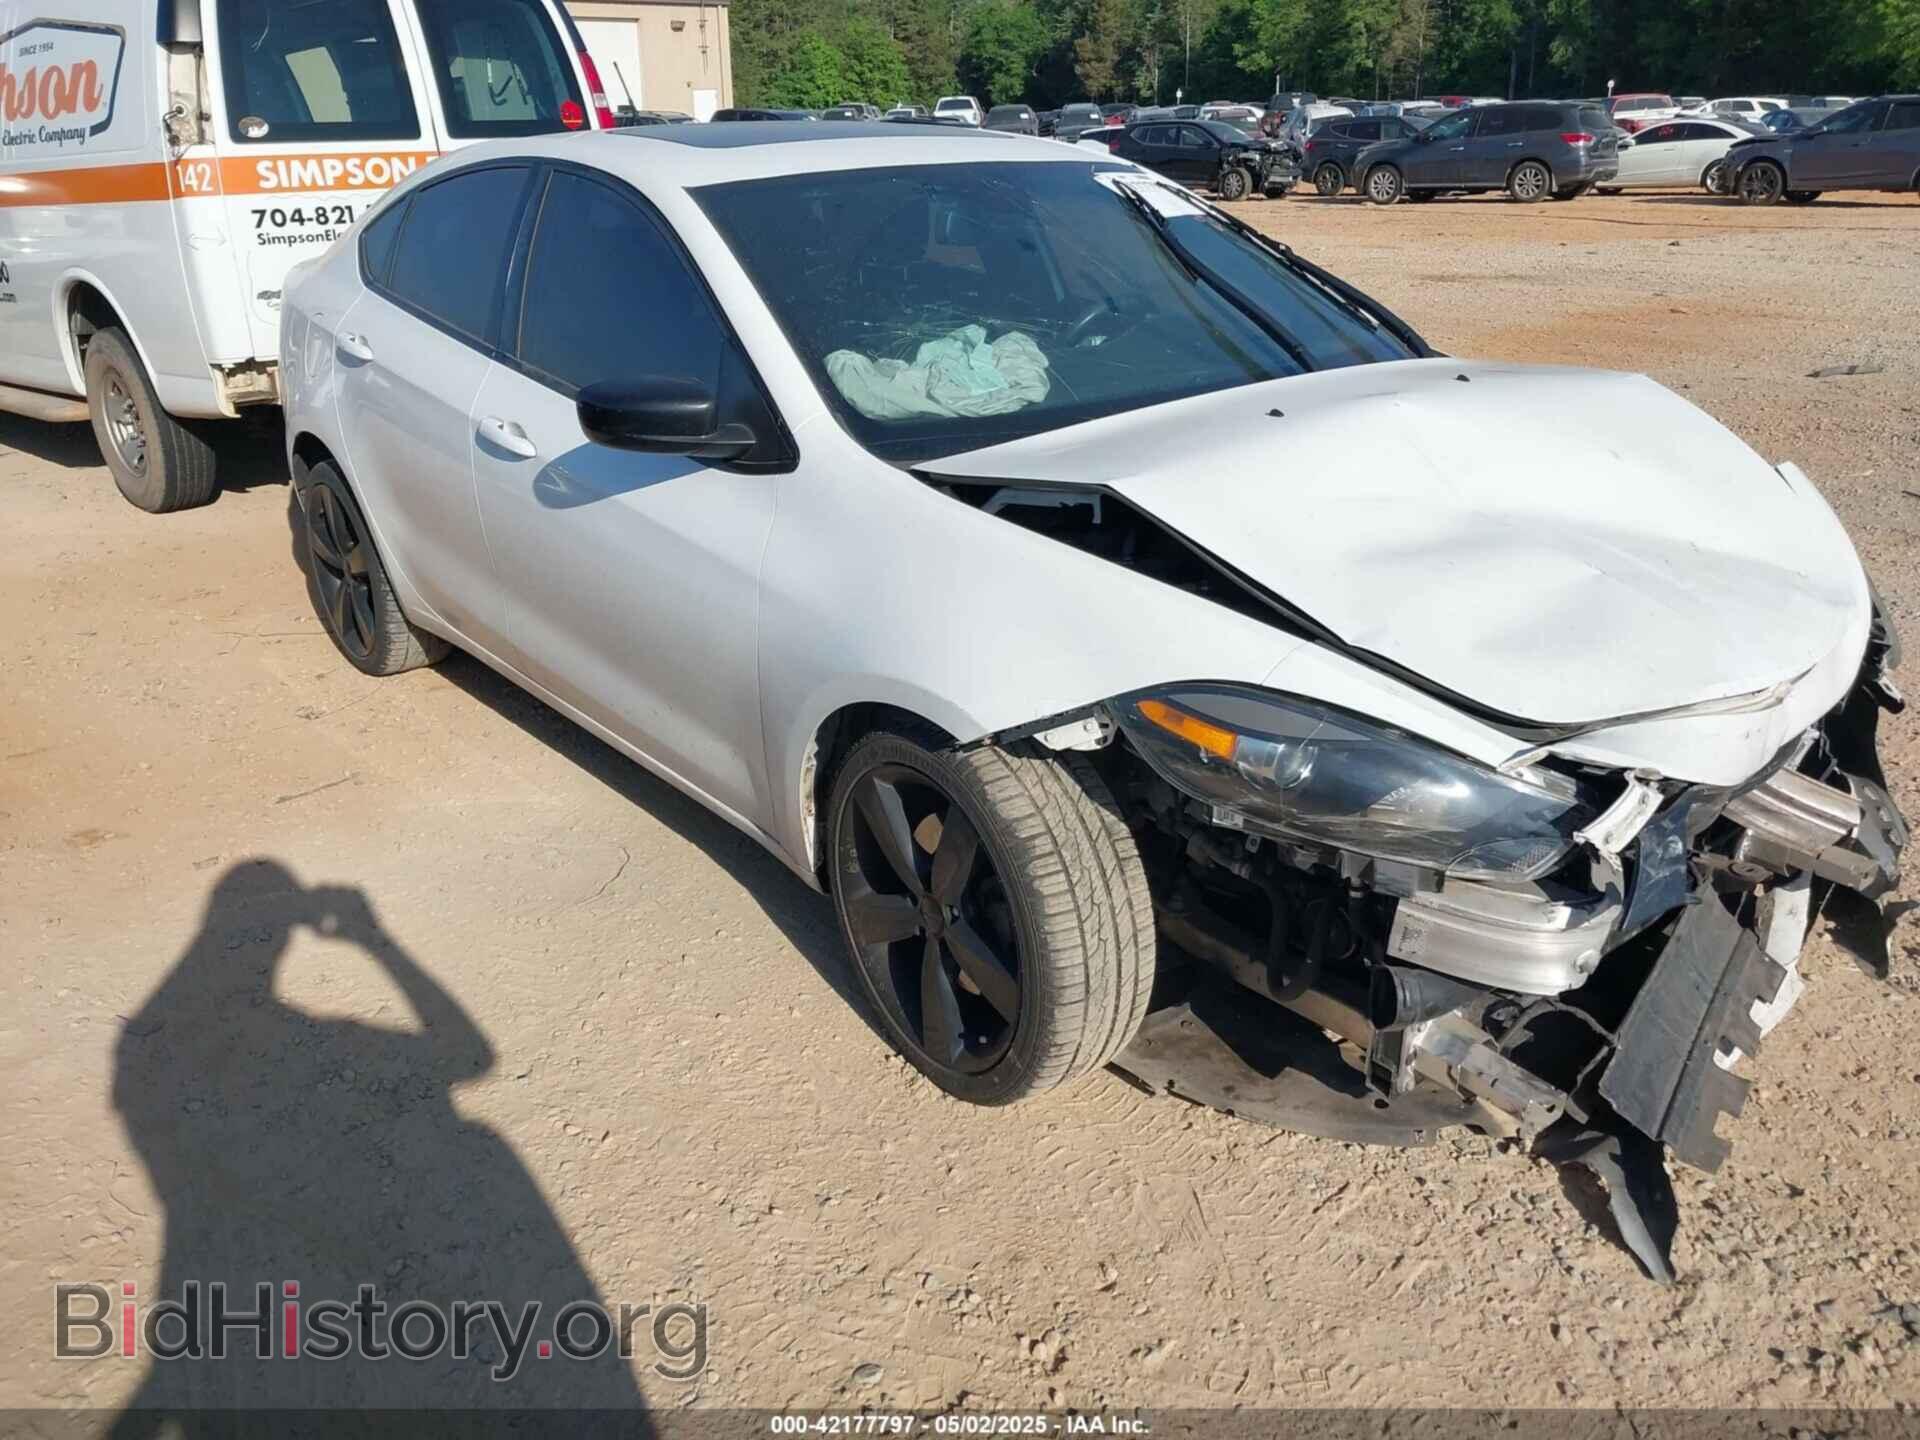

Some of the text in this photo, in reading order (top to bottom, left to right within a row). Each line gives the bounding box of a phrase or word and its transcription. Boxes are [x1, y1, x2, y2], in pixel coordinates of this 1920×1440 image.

[19, 44, 37, 57] SINCE
[3, 125, 86, 147] Electric Company
[176, 163, 213, 193] 142
[256, 155, 416, 189] SIMPSON
